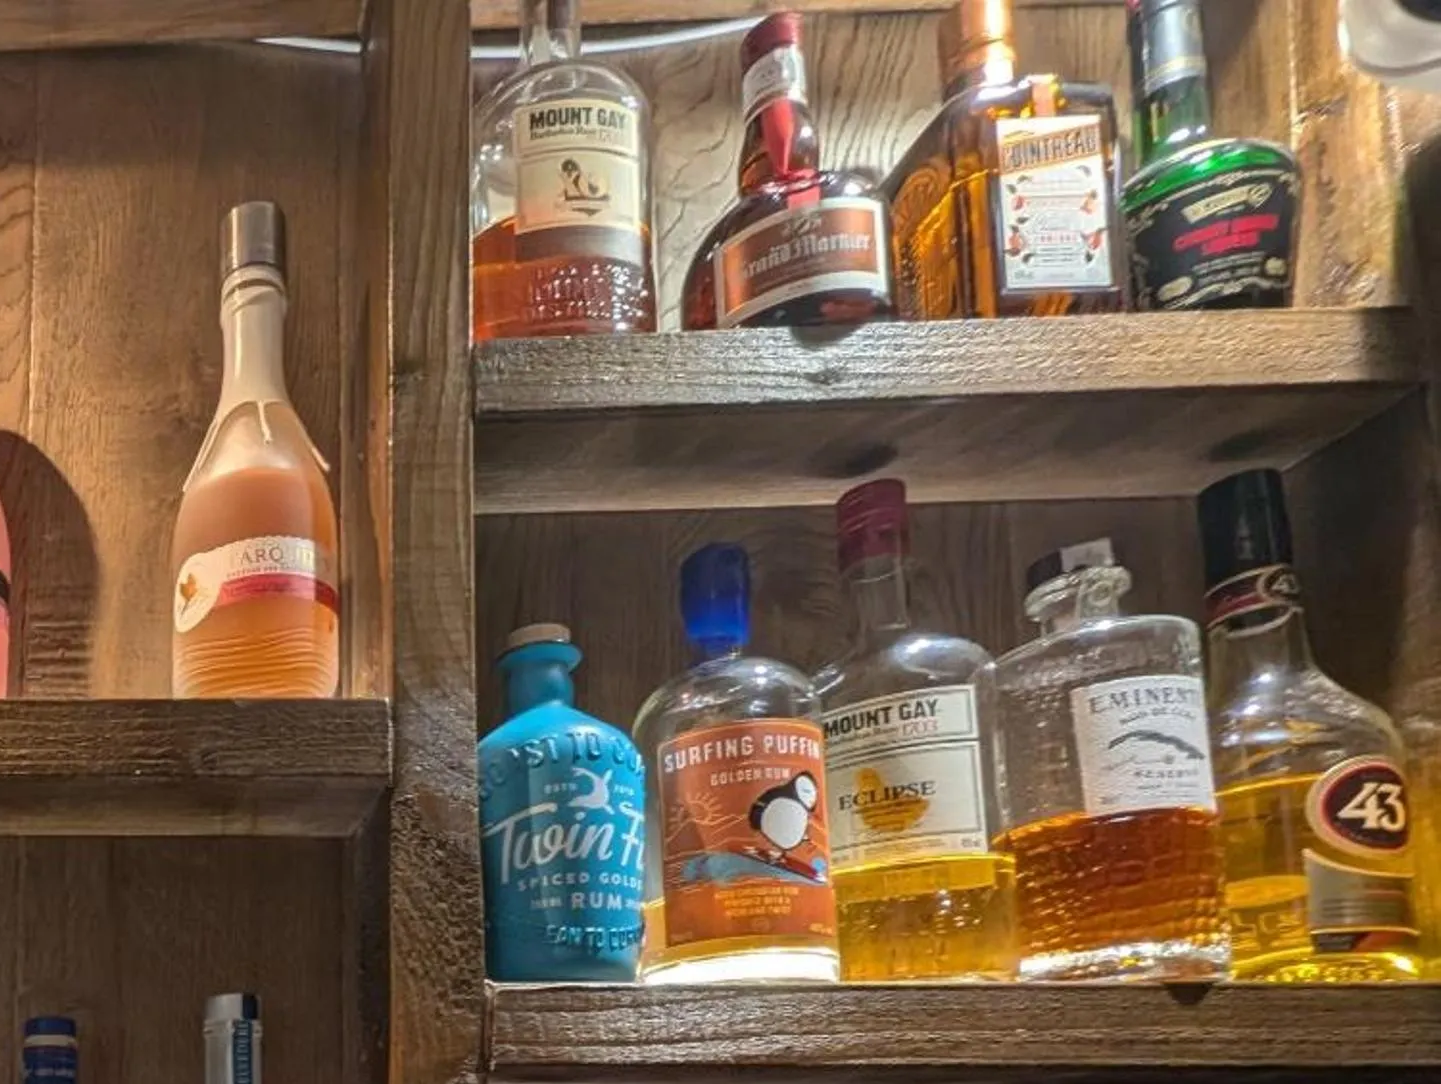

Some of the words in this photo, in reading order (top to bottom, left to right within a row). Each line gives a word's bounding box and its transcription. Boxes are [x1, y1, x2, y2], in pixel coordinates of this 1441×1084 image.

[529, 107, 593, 131] MOUNT
[597, 108, 627, 130] GAY
[823, 706, 893, 741] MOUNT
[898, 699, 939, 722] GAY
[663, 735, 755, 774] SURFING
[762, 735, 821, 761] PUFFIN
[710, 770, 762, 786] GOLDEN
[765, 768, 792, 780] RUM
[838, 779, 938, 811] ECLIPSE
[1337, 781, 1406, 830] 43
[482, 802, 613, 886] Twin
[516, 872, 590, 893] SPICED
[570, 892, 622, 911] RUM
